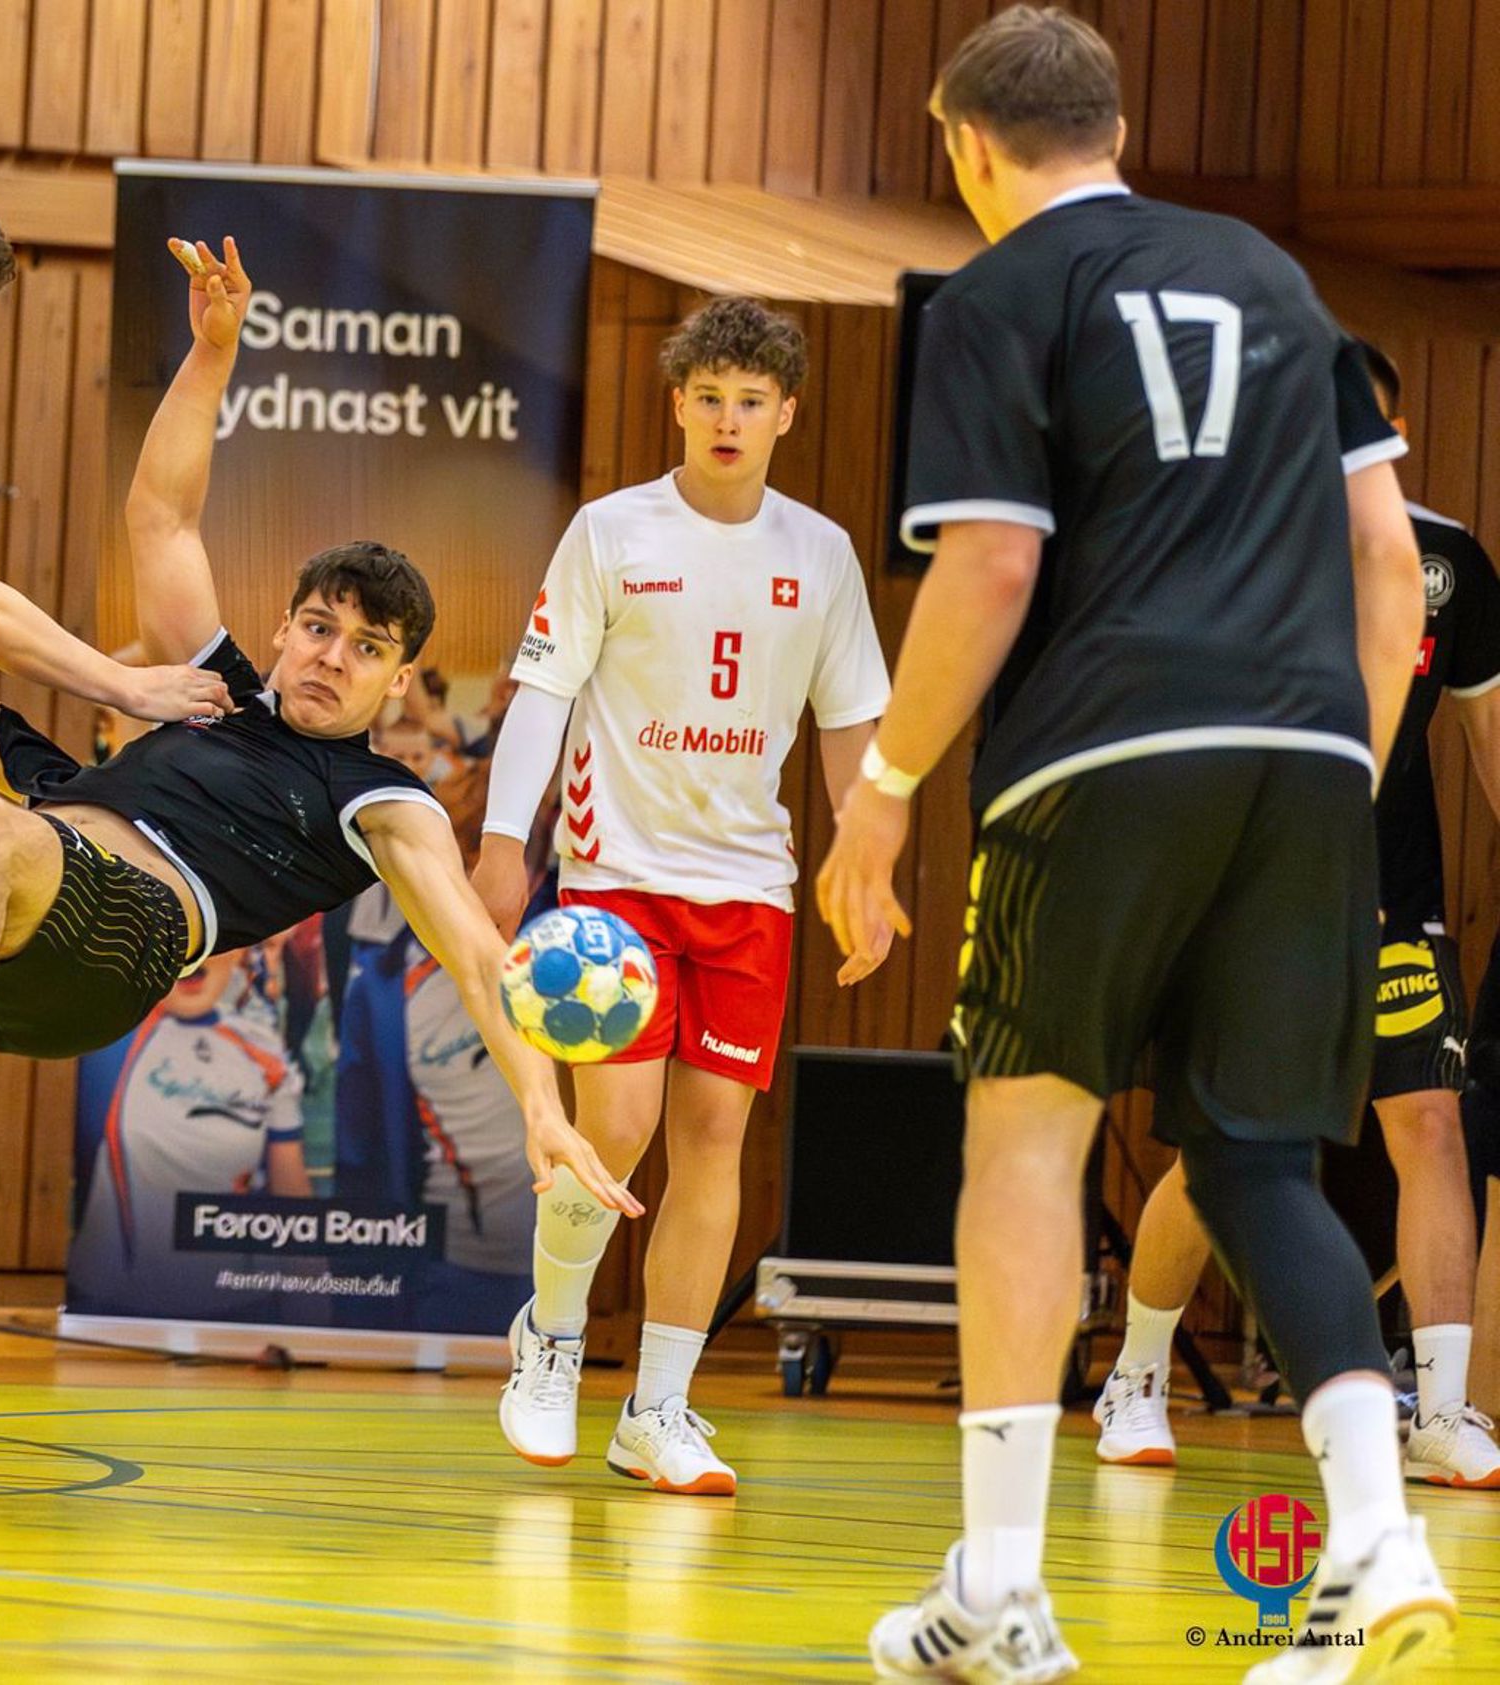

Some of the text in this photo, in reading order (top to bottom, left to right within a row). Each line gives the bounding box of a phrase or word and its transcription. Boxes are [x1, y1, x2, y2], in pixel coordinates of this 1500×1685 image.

[240, 290, 462, 359] Saman
[1114, 288, 1243, 463] 17
[214, 373, 519, 441] ydnast vit
[623, 576, 684, 596] hummel
[710, 630, 742, 701] 5
[637, 719, 769, 757] die Mobili
[700, 1029, 762, 1065] hummel
[193, 1204, 428, 1249] Føroya Banki
